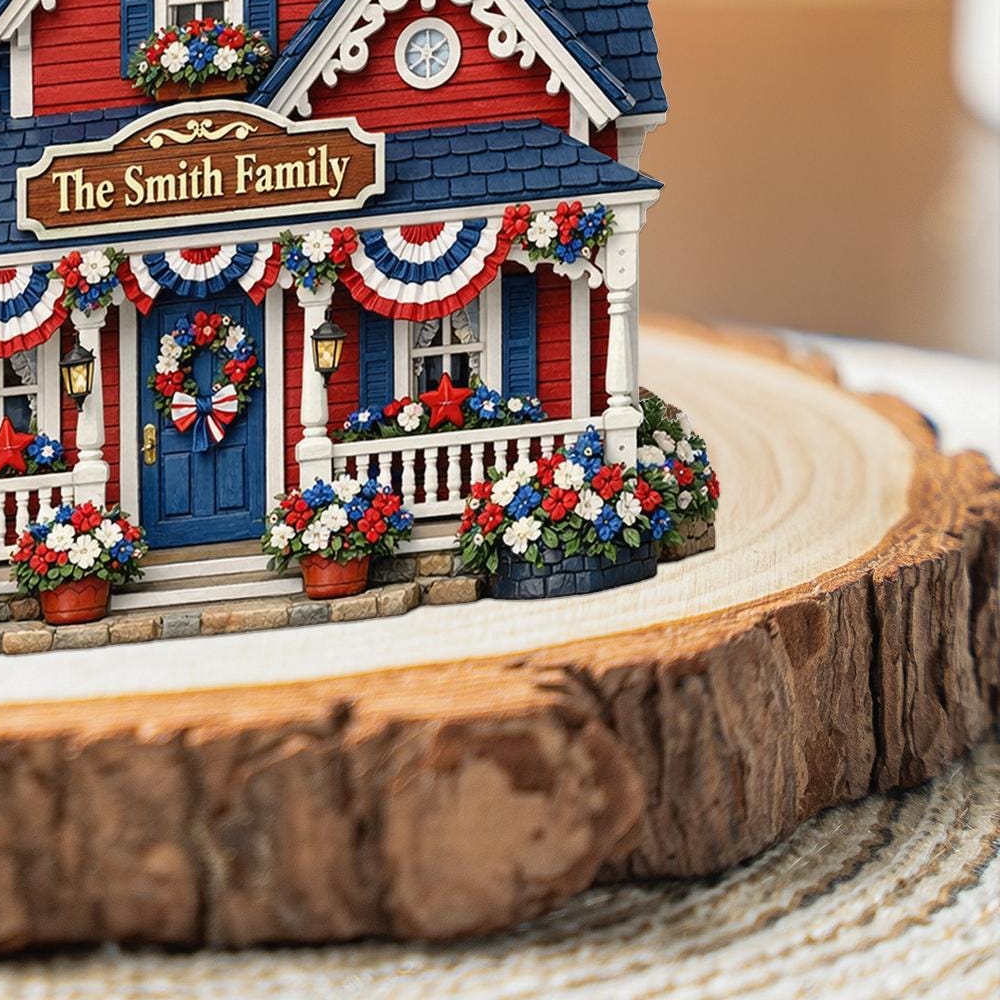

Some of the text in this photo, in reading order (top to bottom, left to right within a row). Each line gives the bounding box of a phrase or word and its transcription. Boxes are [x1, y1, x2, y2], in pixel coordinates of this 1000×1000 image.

[52, 144, 350, 213] The Smith Family
